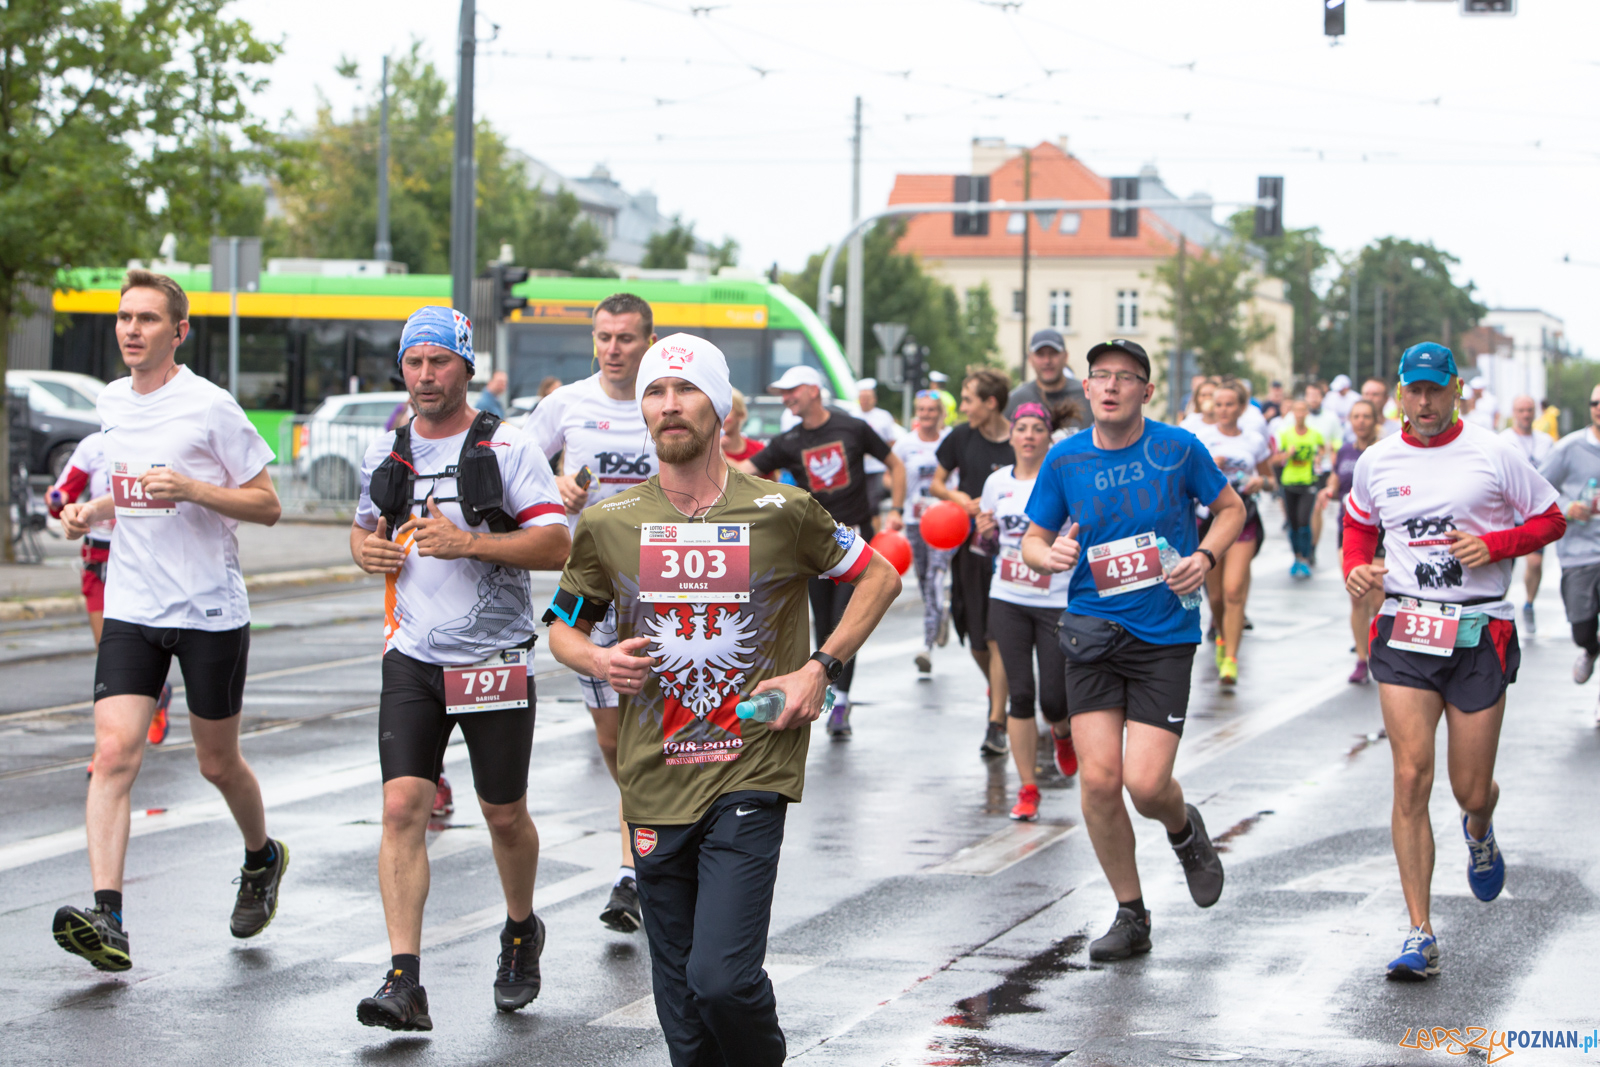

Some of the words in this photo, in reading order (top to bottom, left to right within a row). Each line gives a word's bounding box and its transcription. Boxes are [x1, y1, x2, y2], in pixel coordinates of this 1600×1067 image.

[594, 451, 651, 476] 1956
[120, 479, 153, 500] 14
[660, 549, 727, 579] 303
[1106, 552, 1149, 579] 432
[1404, 614, 1444, 639] 331
[461, 669, 511, 695] 797
[475, 694, 500, 702] DARIUSZ
[662, 737, 744, 755] 1918-2018
